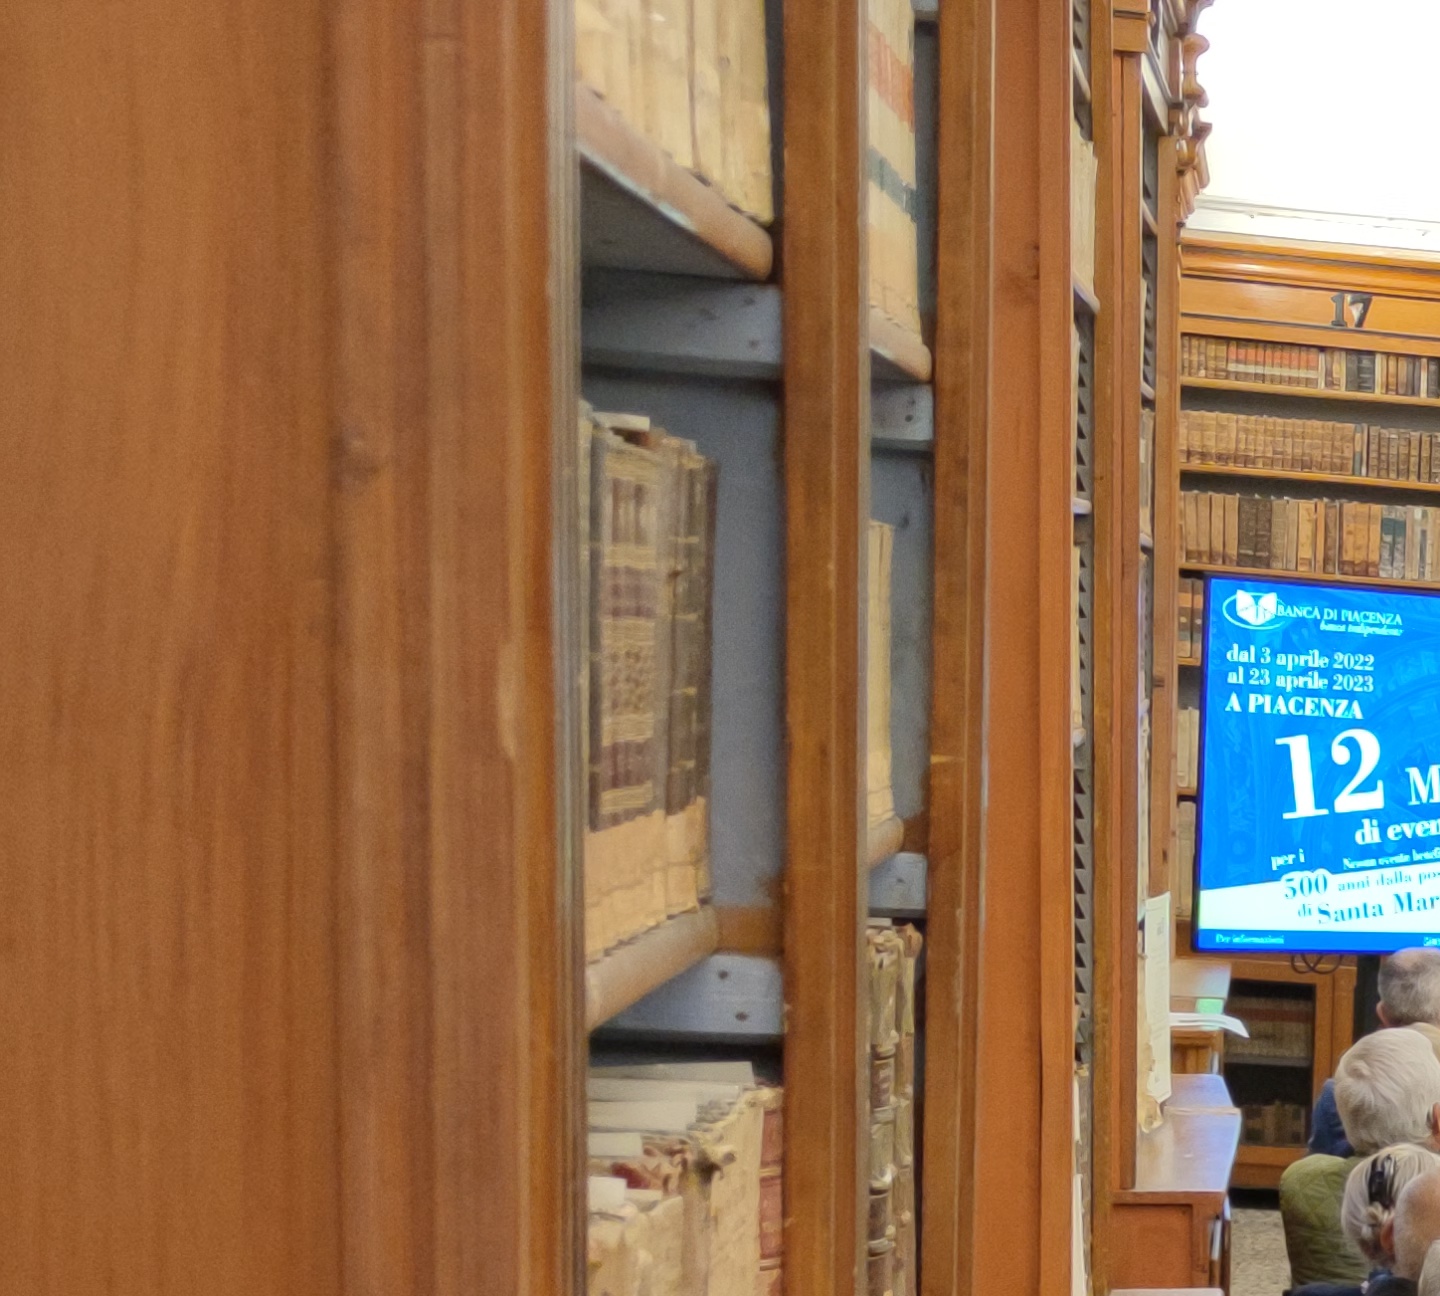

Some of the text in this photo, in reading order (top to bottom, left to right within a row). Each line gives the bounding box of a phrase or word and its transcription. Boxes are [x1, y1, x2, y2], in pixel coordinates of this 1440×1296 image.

[1330, 292, 1373, 328] 17
[1277, 605, 1403, 625] BANCA DI PIACENZA
[1226, 643, 1375, 671] dal 3 aprile 2022
[1227, 666, 1374, 692] al 23 aprile 2023
[1225, 691, 1365, 720] A PIACENZA
[1275, 728, 1385, 820] 12
[1354, 818, 1382, 845] di
[1271, 848, 1305, 871] per i
[1284, 873, 1328, 900] 500
[1337, 875, 1370, 892] anni
[1377, 871, 1412, 887] dalla
[1298, 903, 1312, 918] di
[1317, 902, 1384, 924] Santa
